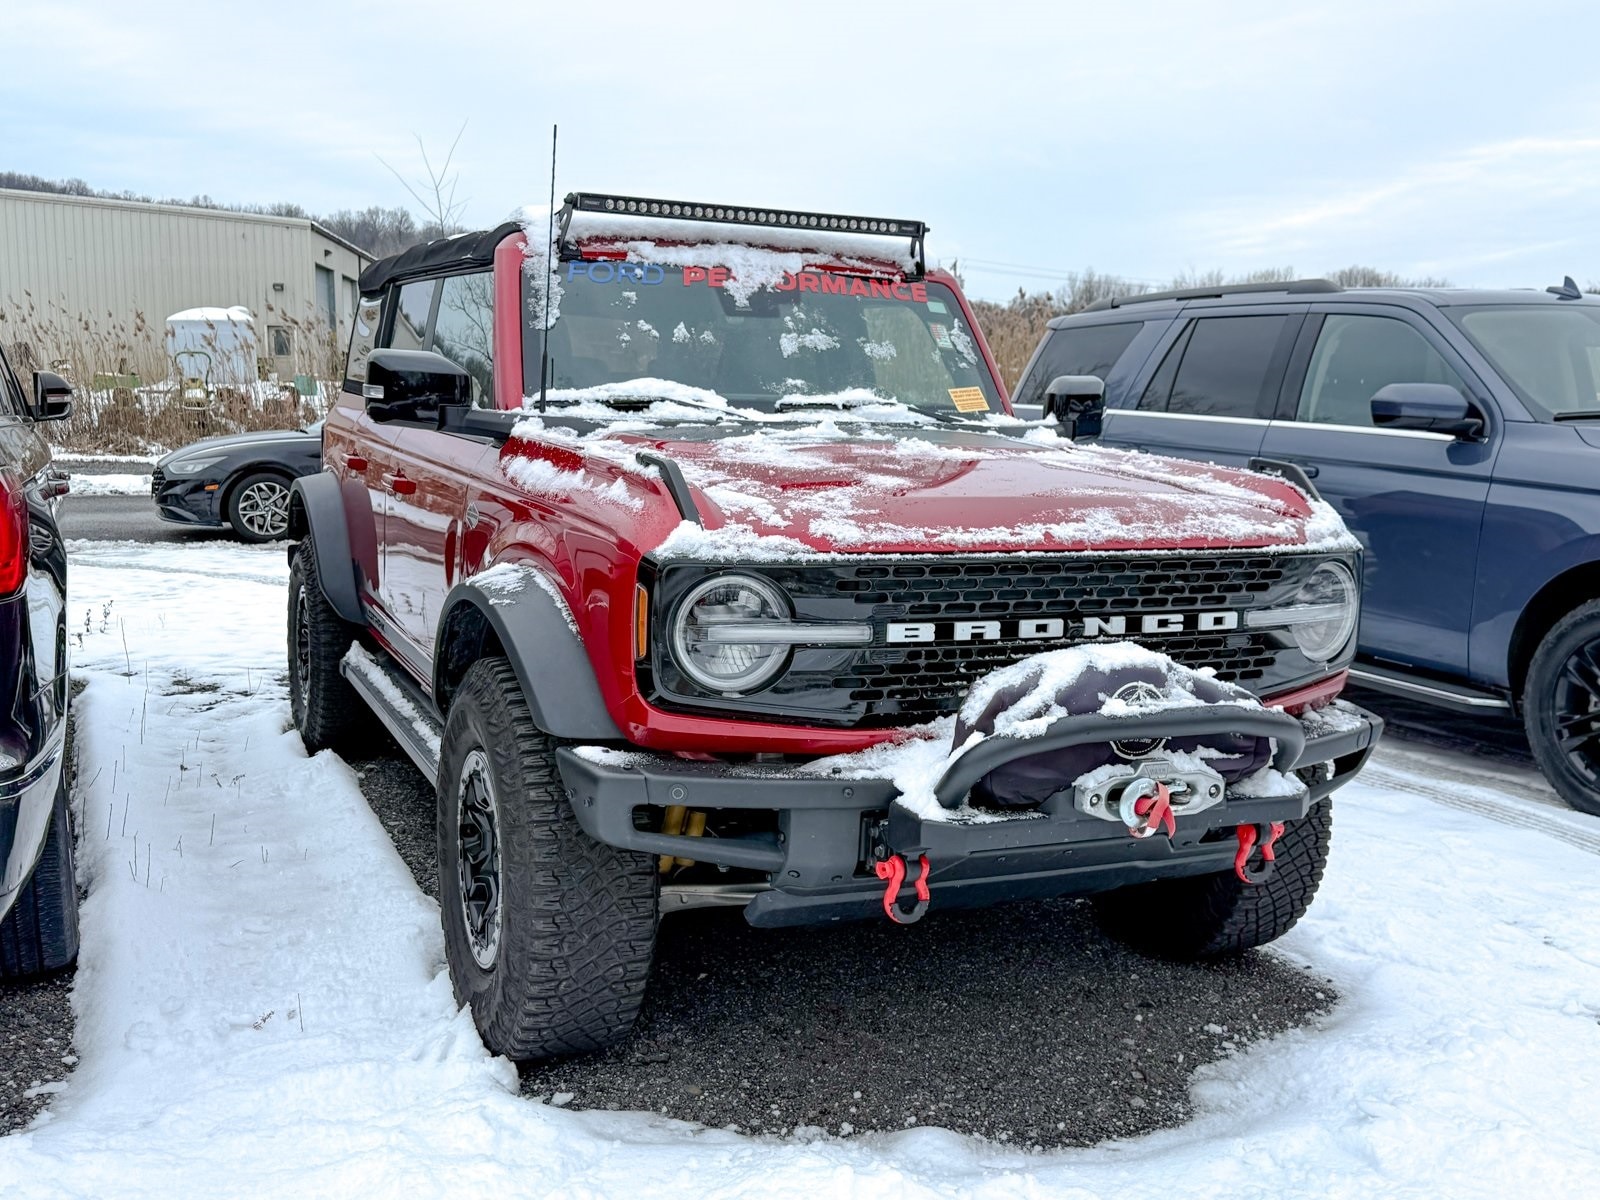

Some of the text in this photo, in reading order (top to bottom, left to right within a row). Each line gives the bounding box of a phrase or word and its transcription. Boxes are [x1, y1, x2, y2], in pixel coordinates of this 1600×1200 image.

[567, 260, 928, 303] FORD PEORMANCE
[887, 612, 1238, 643] BRONCO
